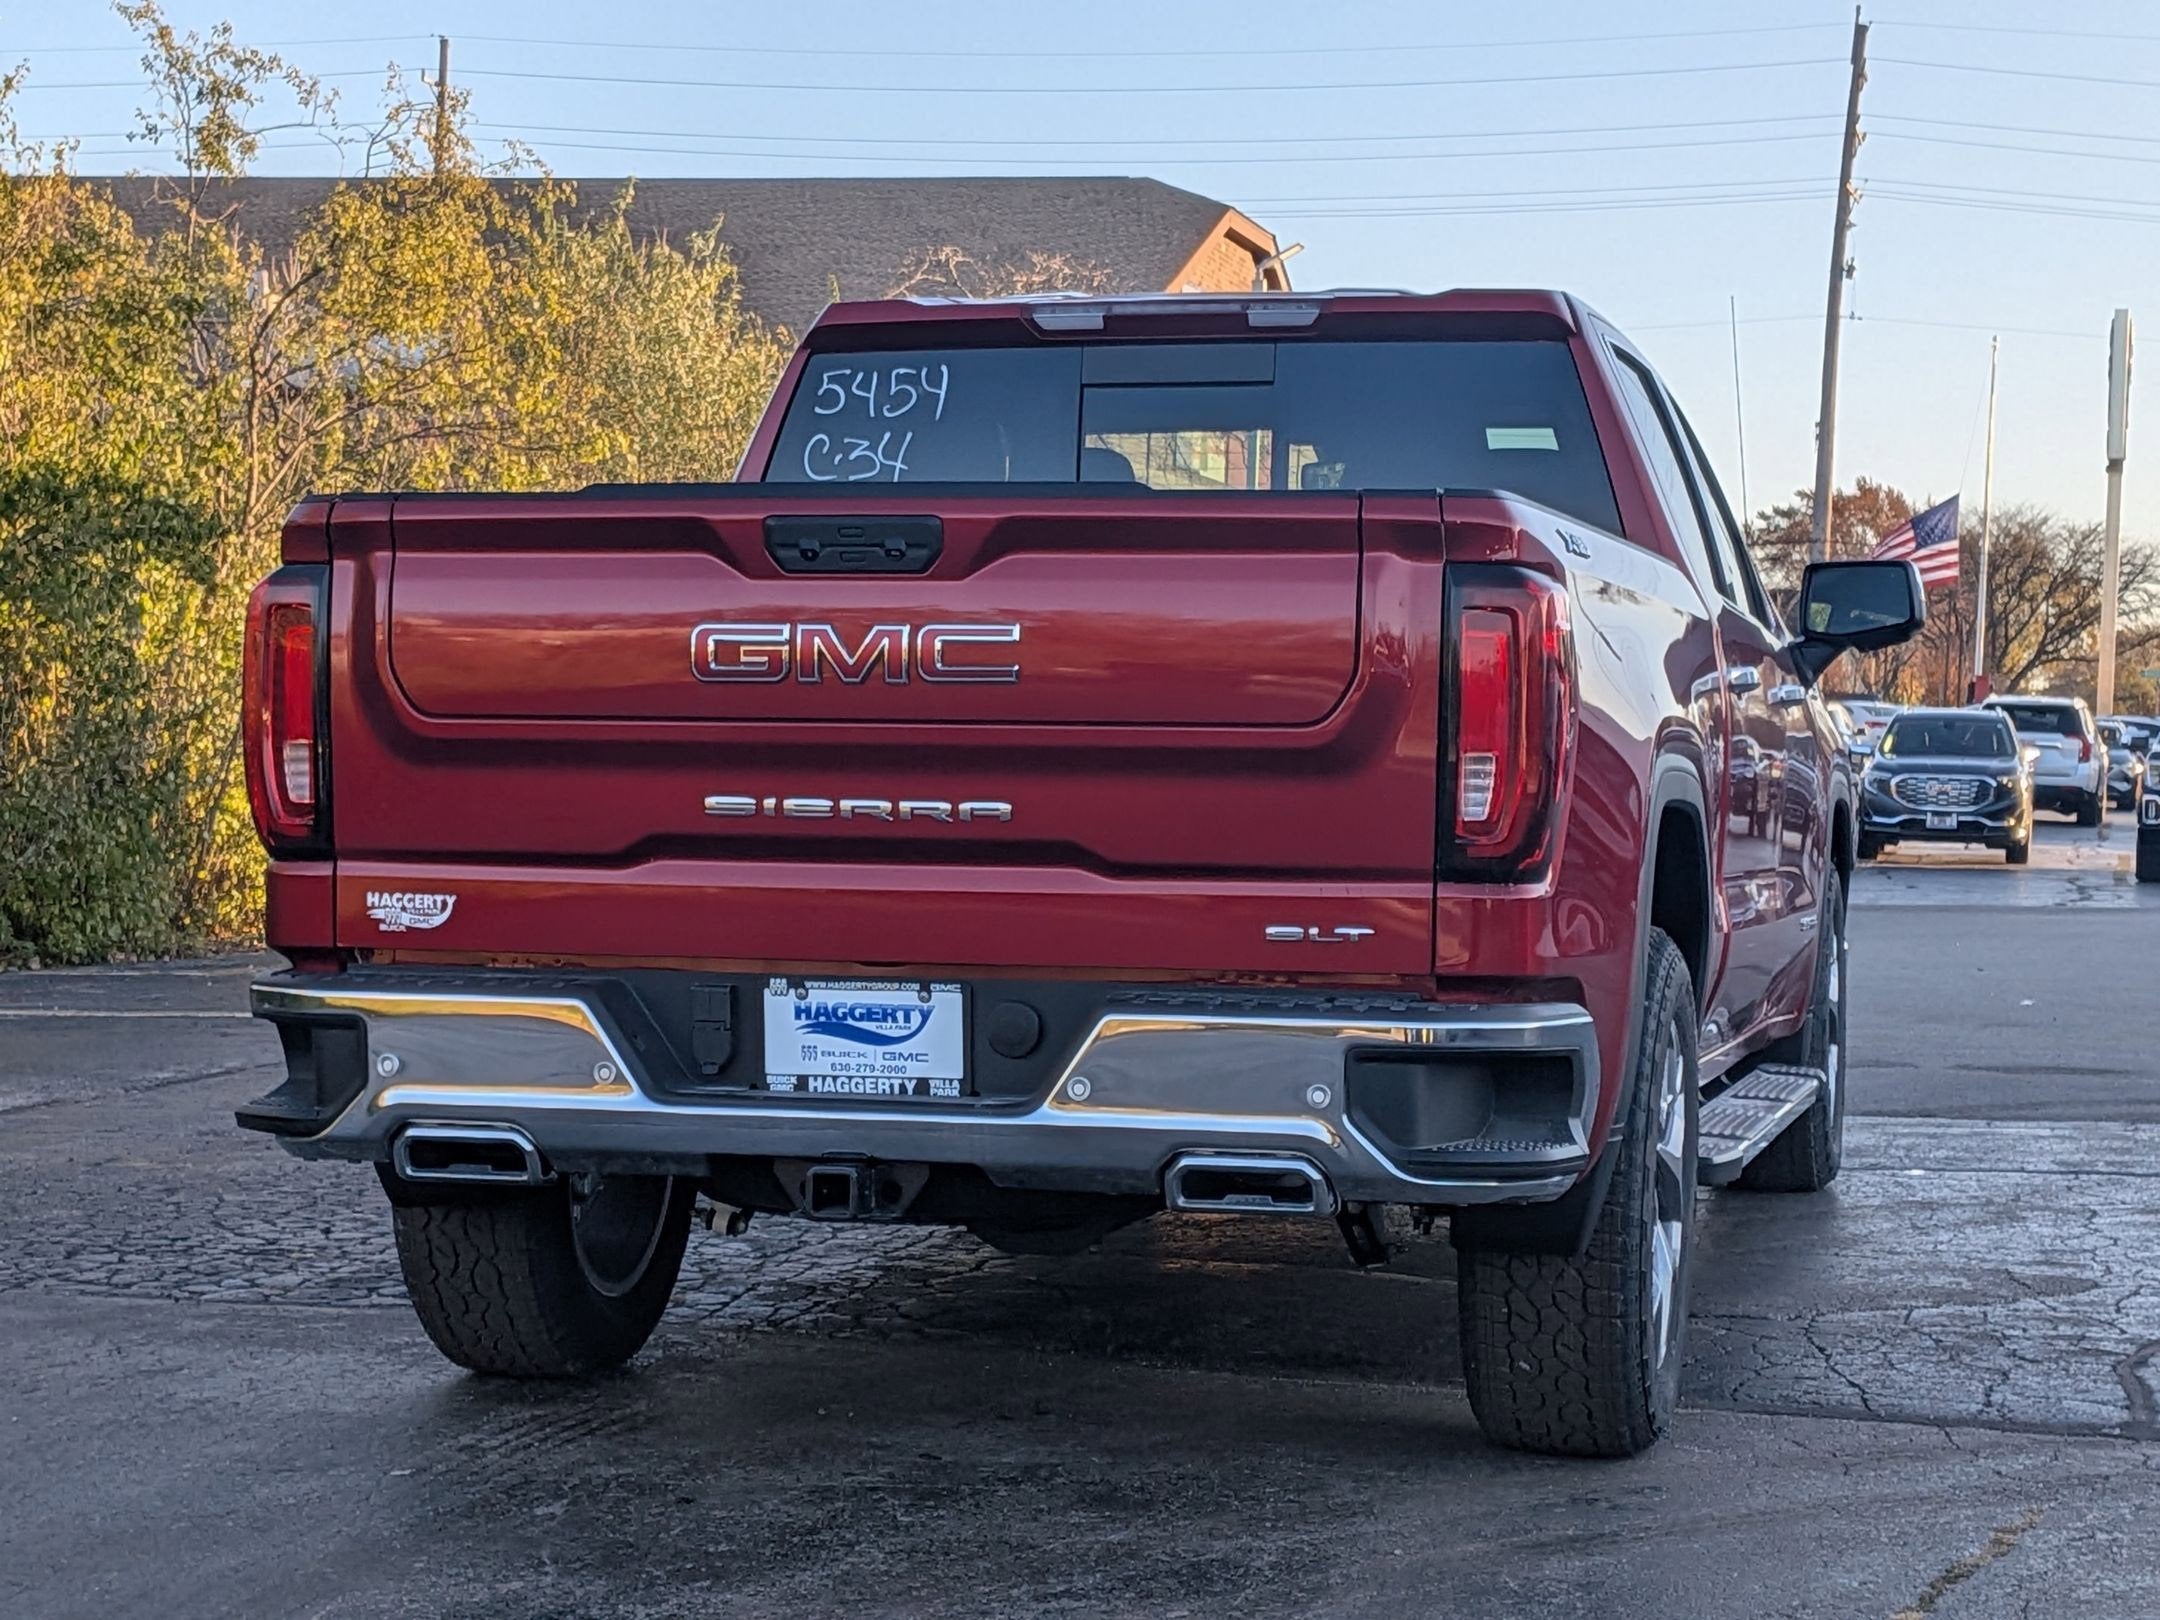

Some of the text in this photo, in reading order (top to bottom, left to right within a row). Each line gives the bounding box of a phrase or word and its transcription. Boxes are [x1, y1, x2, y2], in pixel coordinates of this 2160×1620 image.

[813, 363, 949, 421] 5454
[690, 622, 1021, 684] GMC
[703, 794, 1014, 822] SIERRA
[366, 891, 457, 911] HAGGERTY
[1264, 925, 1376, 943] SLT
[930, 983, 962, 993] GMC
[793, 1001, 936, 1024] HAGGERTY
[820, 1050, 929, 1063] BUICK GMC
[830, 1062, 908, 1075] 630-279-2000
[766, 1075, 797, 1084] BUICK
[808, 1076, 917, 1096] HAGGERTY
[929, 1079, 960, 1088] VILLA
[929, 1087, 960, 1097] PARK
